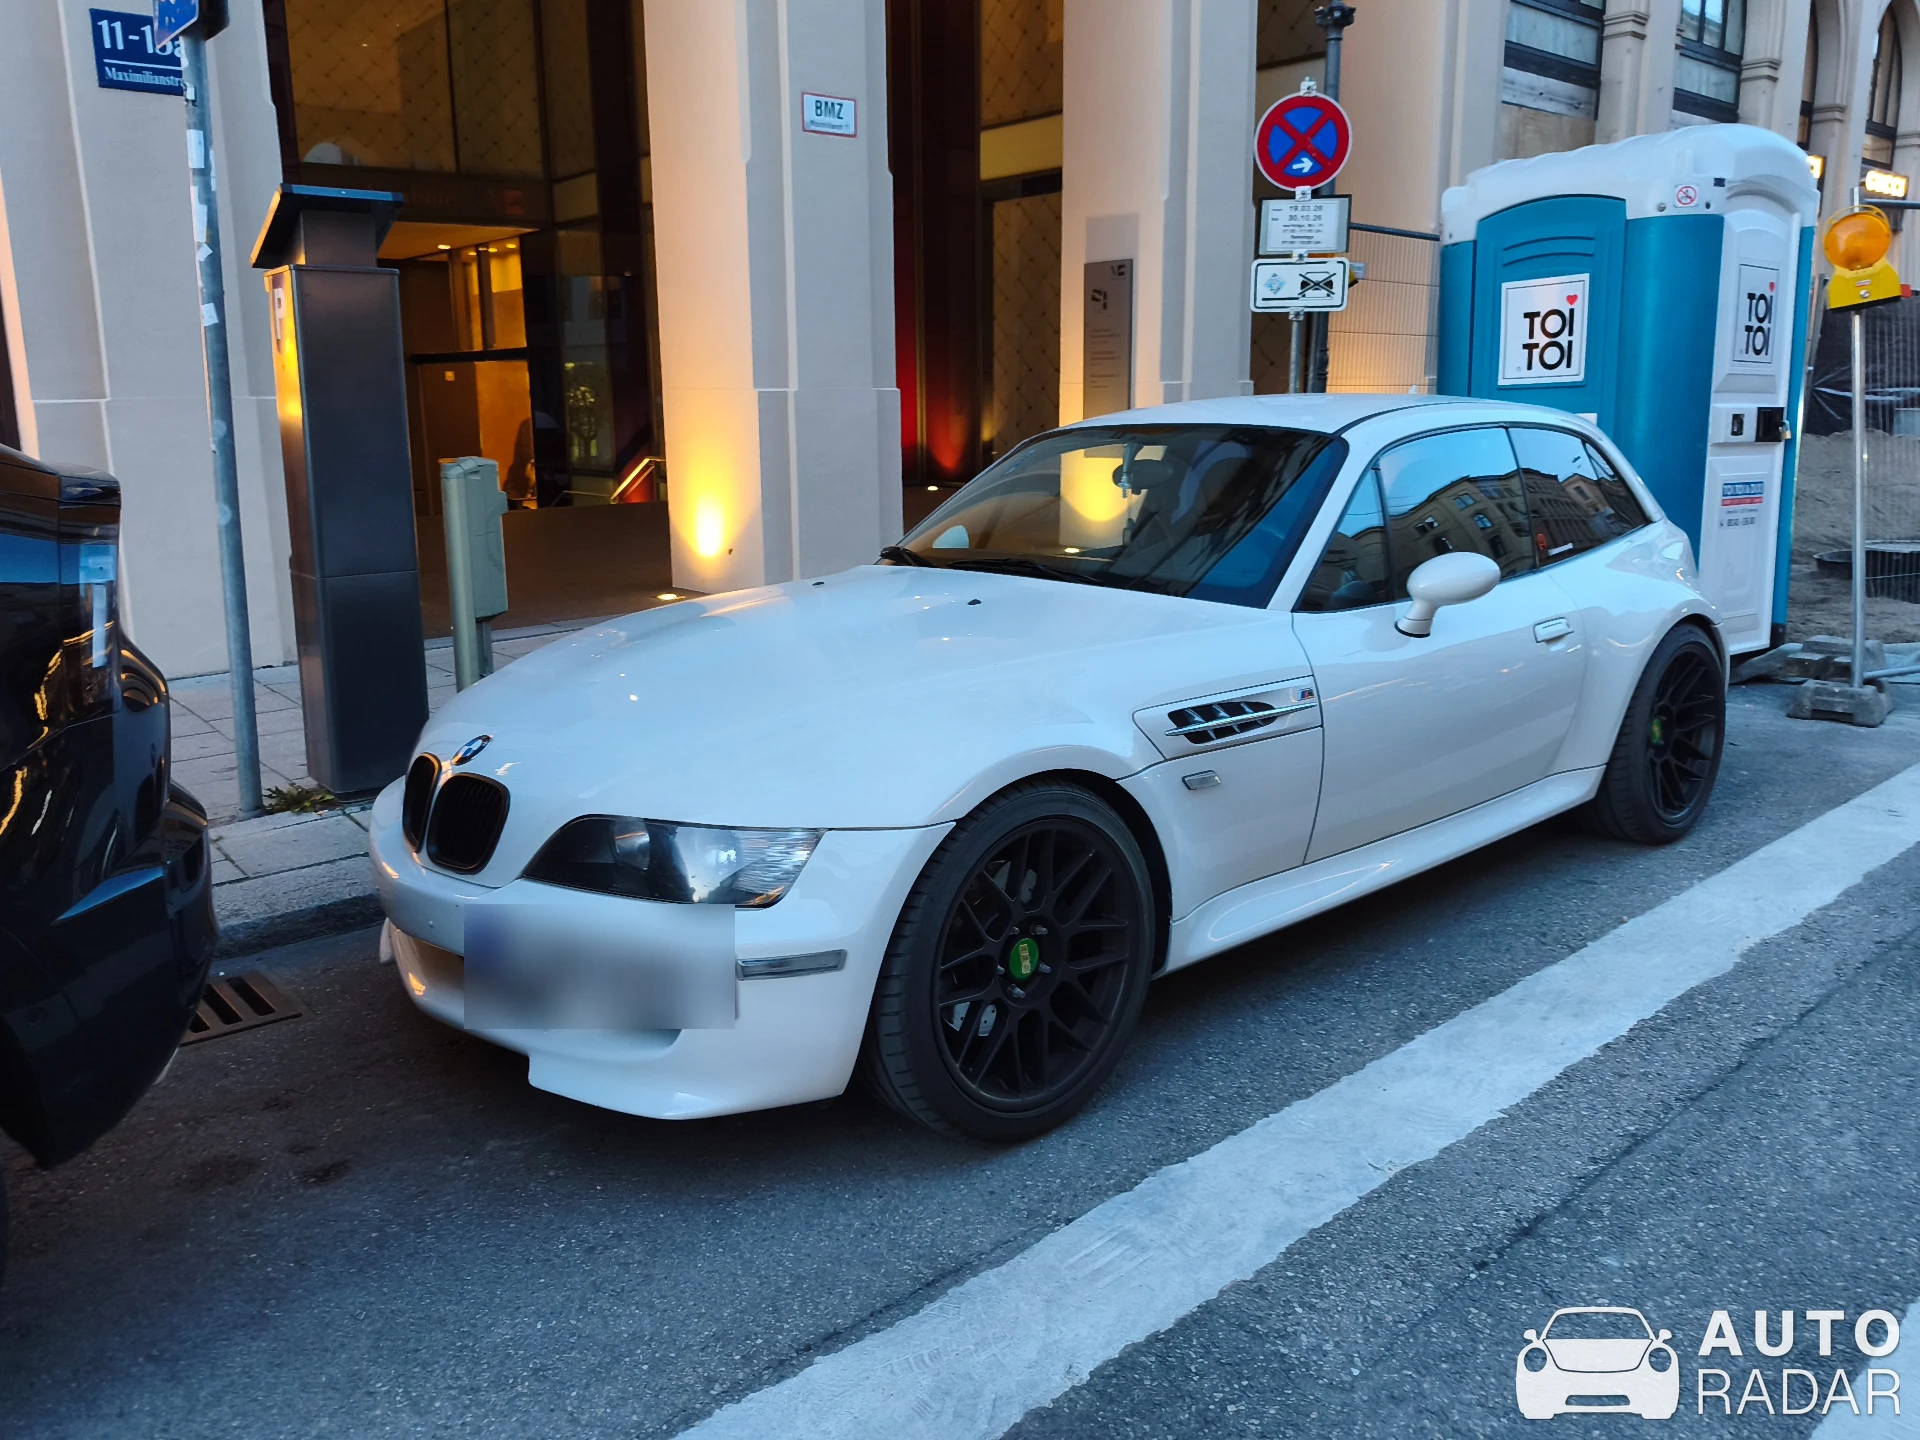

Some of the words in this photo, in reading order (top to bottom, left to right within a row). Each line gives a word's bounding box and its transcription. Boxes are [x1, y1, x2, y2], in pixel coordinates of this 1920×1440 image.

[815, 99, 844, 120] BMZ
[1522, 340, 1573, 371] TOI
[1744, 324, 1771, 356] TOI
